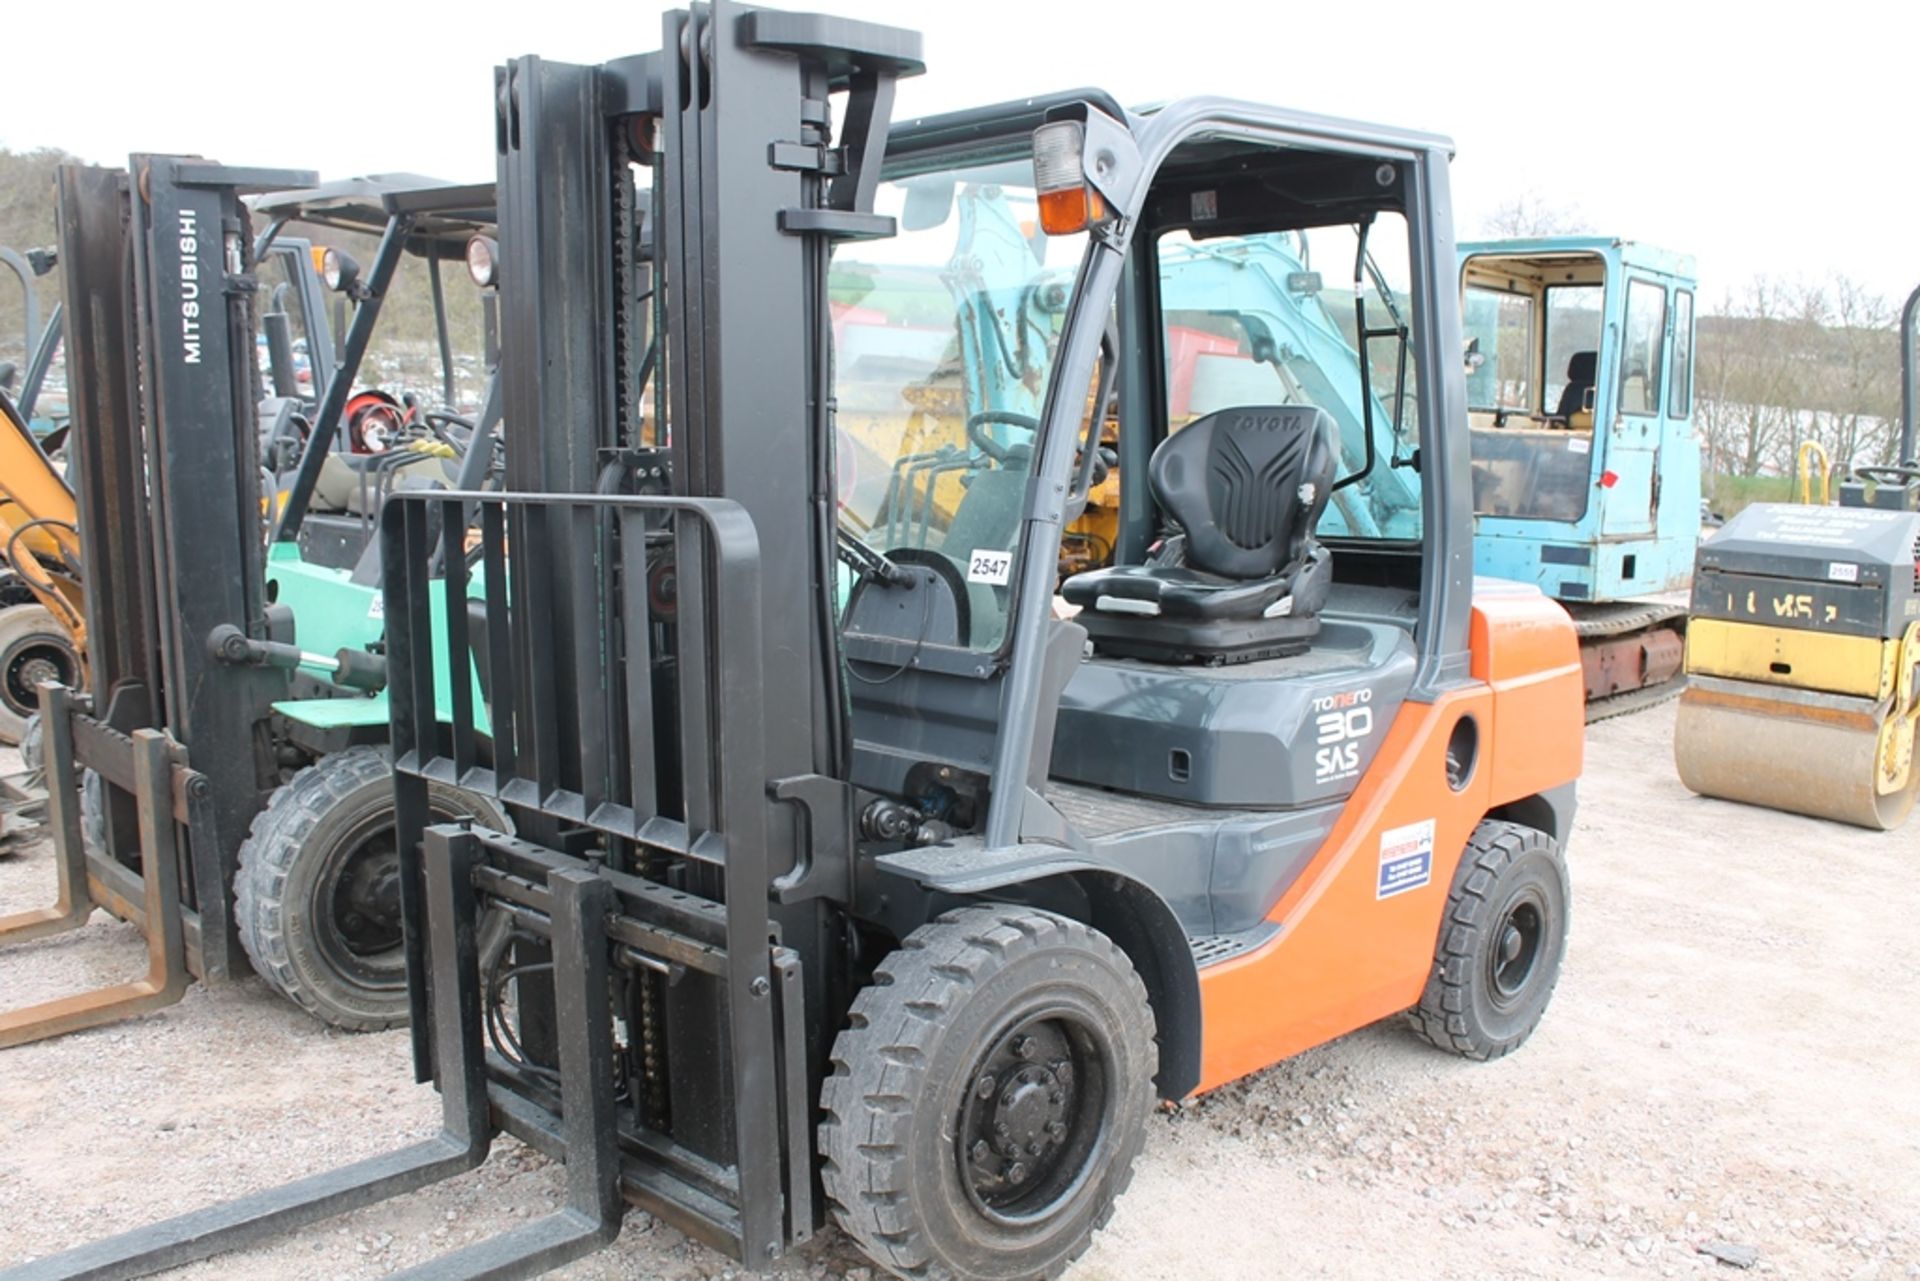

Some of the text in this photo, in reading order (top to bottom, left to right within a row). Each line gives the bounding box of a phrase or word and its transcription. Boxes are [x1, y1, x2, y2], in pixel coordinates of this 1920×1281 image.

[179, 208, 201, 364] MITSUBISHI
[1231, 415, 1302, 433] TOYOTA
[971, 557, 1008, 577] 2547
[1315, 706, 1374, 746] 30
[1315, 741, 1360, 777] SAS
